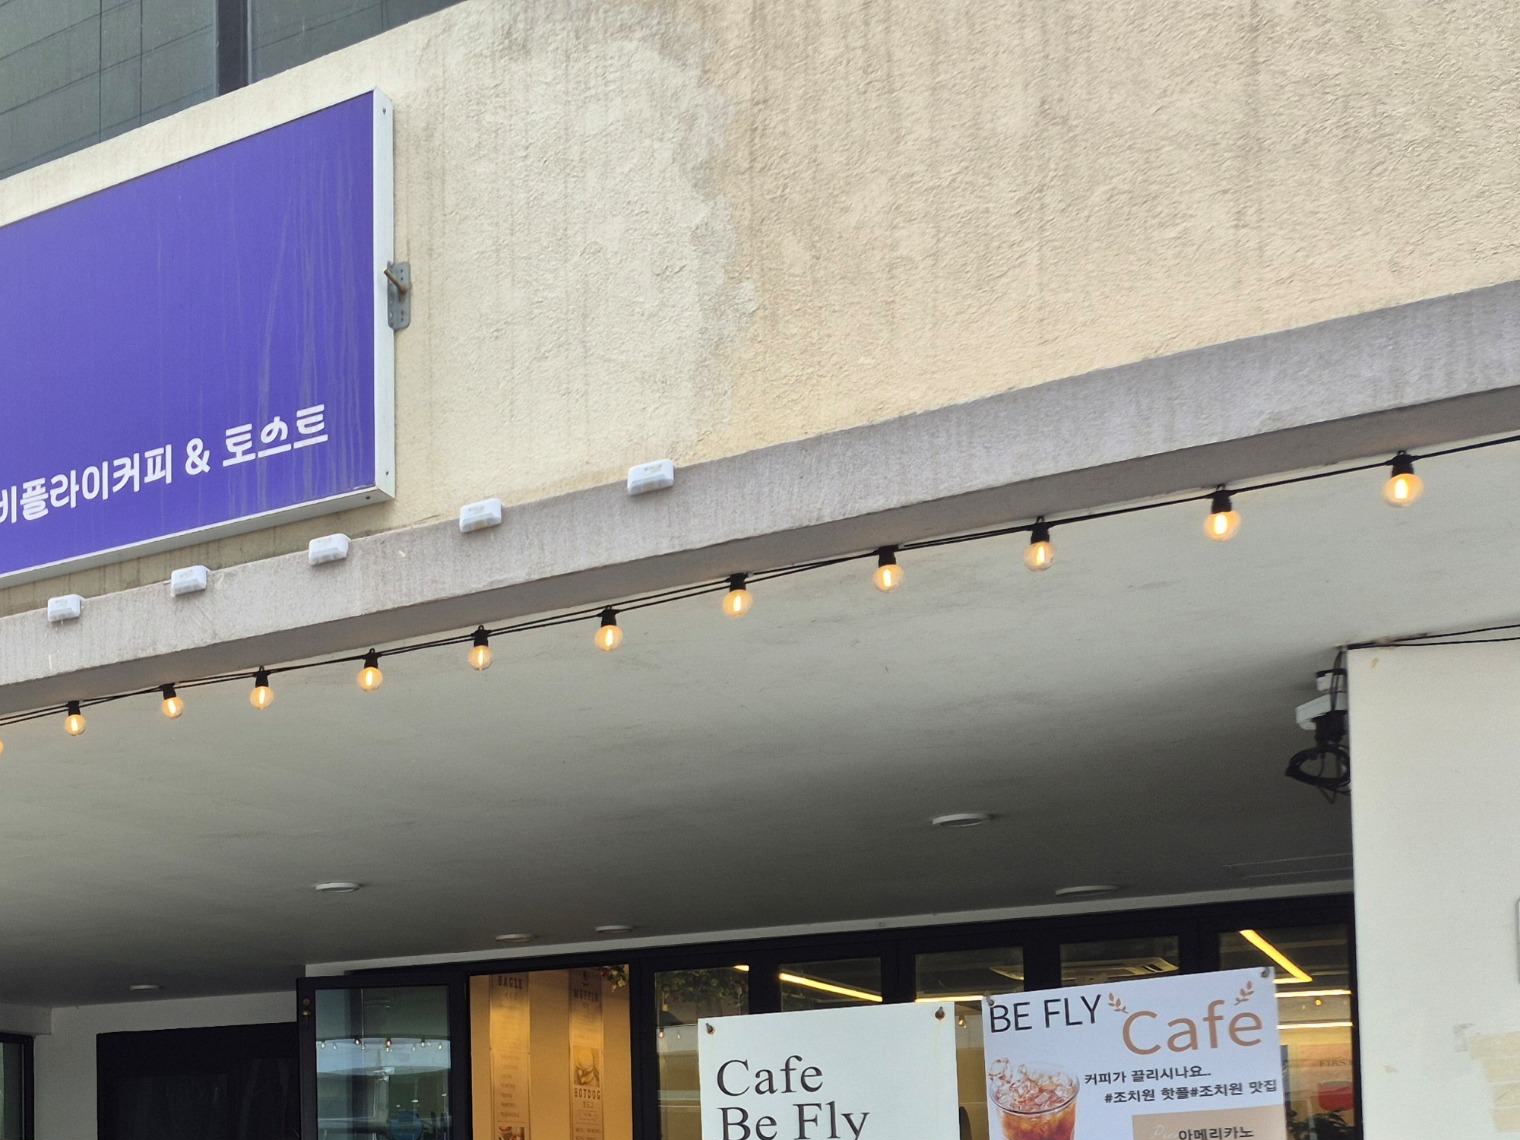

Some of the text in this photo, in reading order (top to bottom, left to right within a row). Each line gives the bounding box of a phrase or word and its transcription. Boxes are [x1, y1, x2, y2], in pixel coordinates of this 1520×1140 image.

[185, 437, 211, 476] &
[222, 403, 328, 467] 토스트
[990, 994, 1102, 1033] BE FLY
[717, 1055, 823, 1096] Cafe
[1084, 1071, 1127, 1086] 커피가
[1105, 1088, 1155, 1104] #조치원
[1249, 1079, 1277, 1095] 맛집
[574, 1088, 601, 1100] HOTDOG
